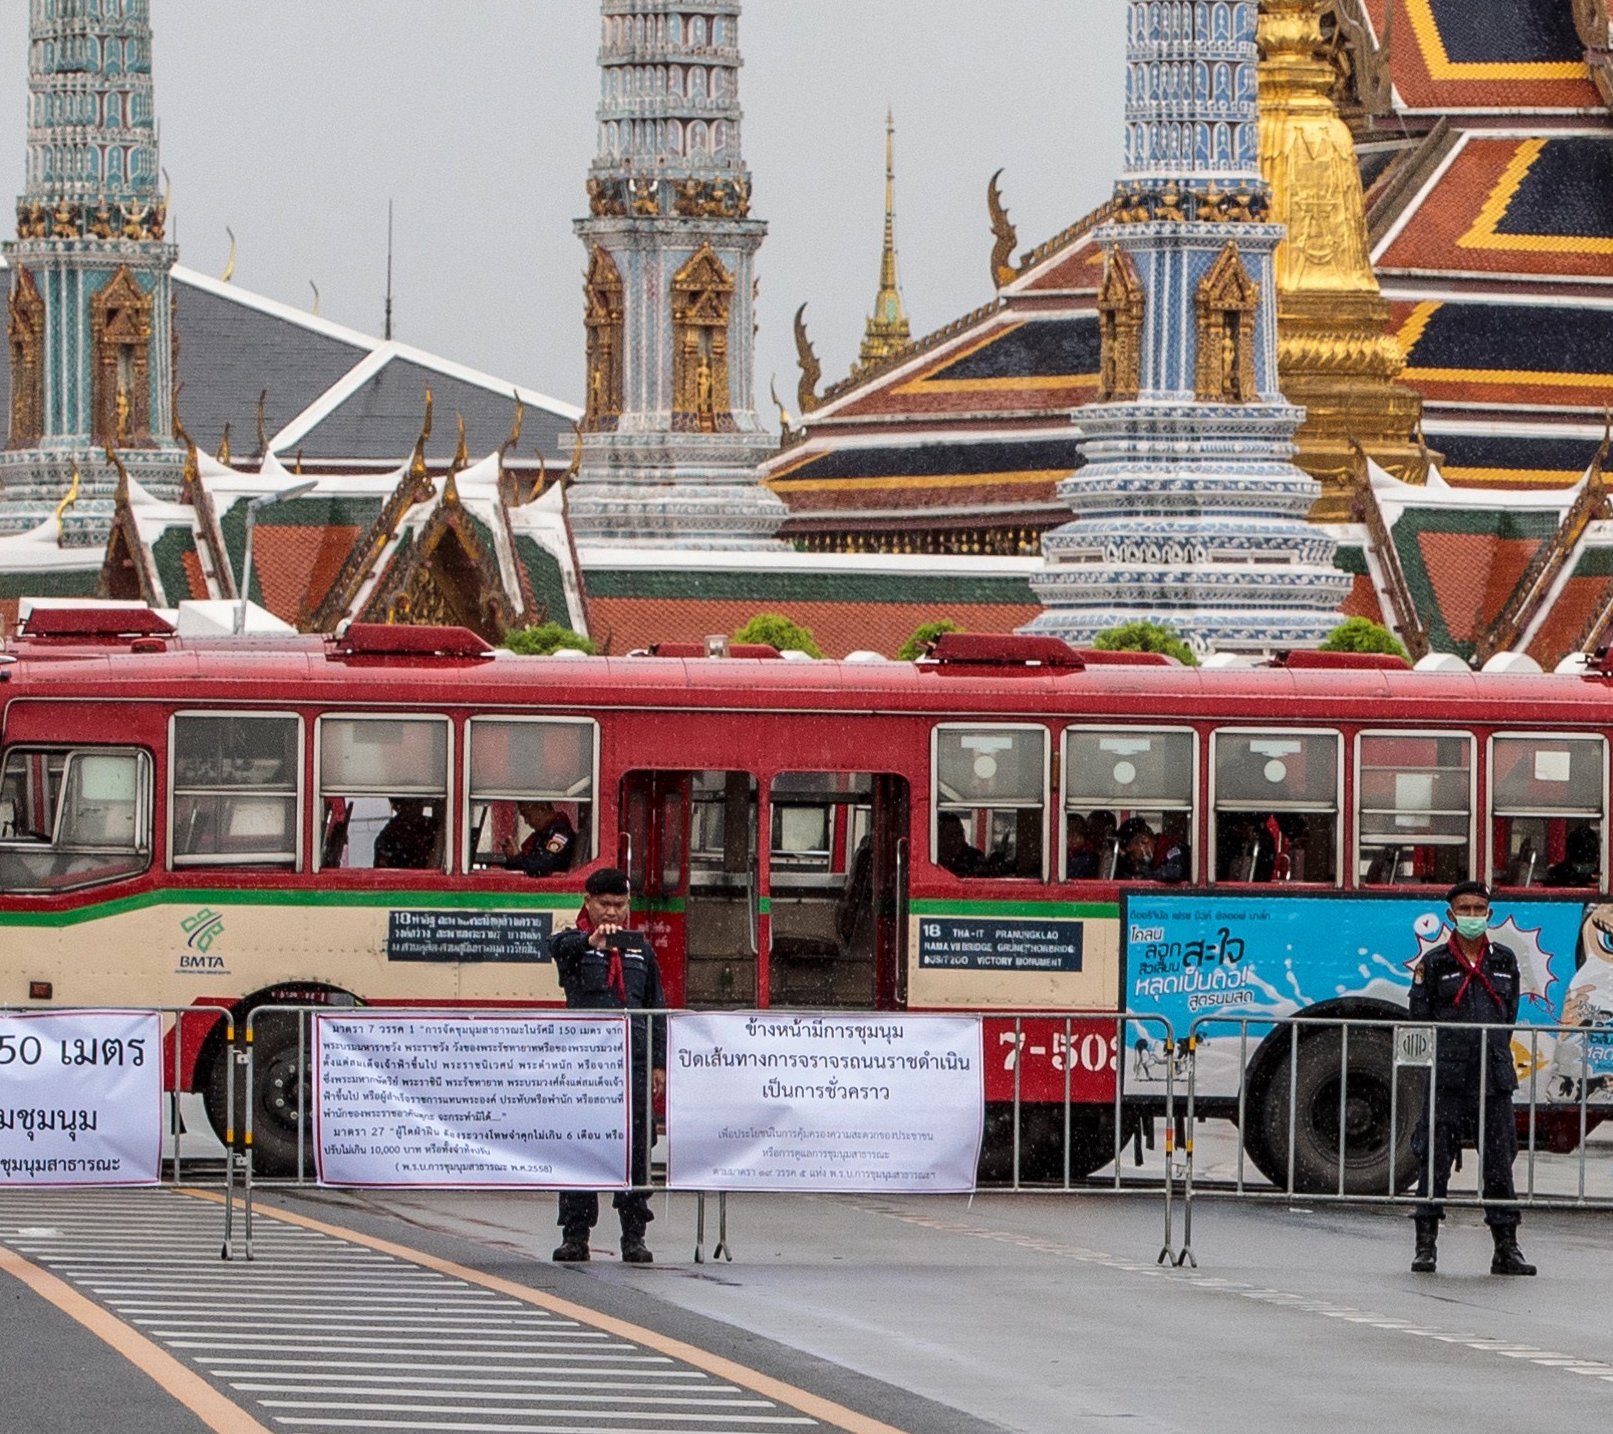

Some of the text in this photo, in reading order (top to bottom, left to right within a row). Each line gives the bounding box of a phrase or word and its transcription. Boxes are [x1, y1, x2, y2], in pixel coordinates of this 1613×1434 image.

[923, 924, 941, 938] 18
[1182, 927, 1245, 967] สะใจ
[180, 955, 225, 968] BMTA
[977, 956, 1013, 966] VICTORY
[332, 1024, 364, 1034] มาตรา
[368, 1025, 375, 1034] 7
[379, 1025, 405, 1034] วรรค
[409, 1025, 415, 1034] 1
[558, 1026, 577, 1035] 150
[580, 1026, 602, 1035] เมตร
[606, 1026, 624, 1035] จาก
[746, 1018, 903, 1045] ข้างหน้ามีการชุมนุม
[61, 1037, 146, 1066] เมตร
[404, 1041, 450, 1053] พระราชวัง
[577, 1058, 624, 1069] หรือจากที่
[678, 1047, 970, 1071] ปิดเส้นทางการจราจรถนนราชดำเนิน
[762, 1076, 890, 1100] เป็นการชั่วคราว
[333, 1127, 366, 1137] มาตรา
[371, 1127, 385, 1137] 27
[566, 1131, 573, 1140] 6
[577, 1129, 601, 1140] เดือน
[605, 1129, 624, 1140] หรือ
[370, 1145, 401, 1155] 10,000
[403, 1145, 422, 1155] บาท
